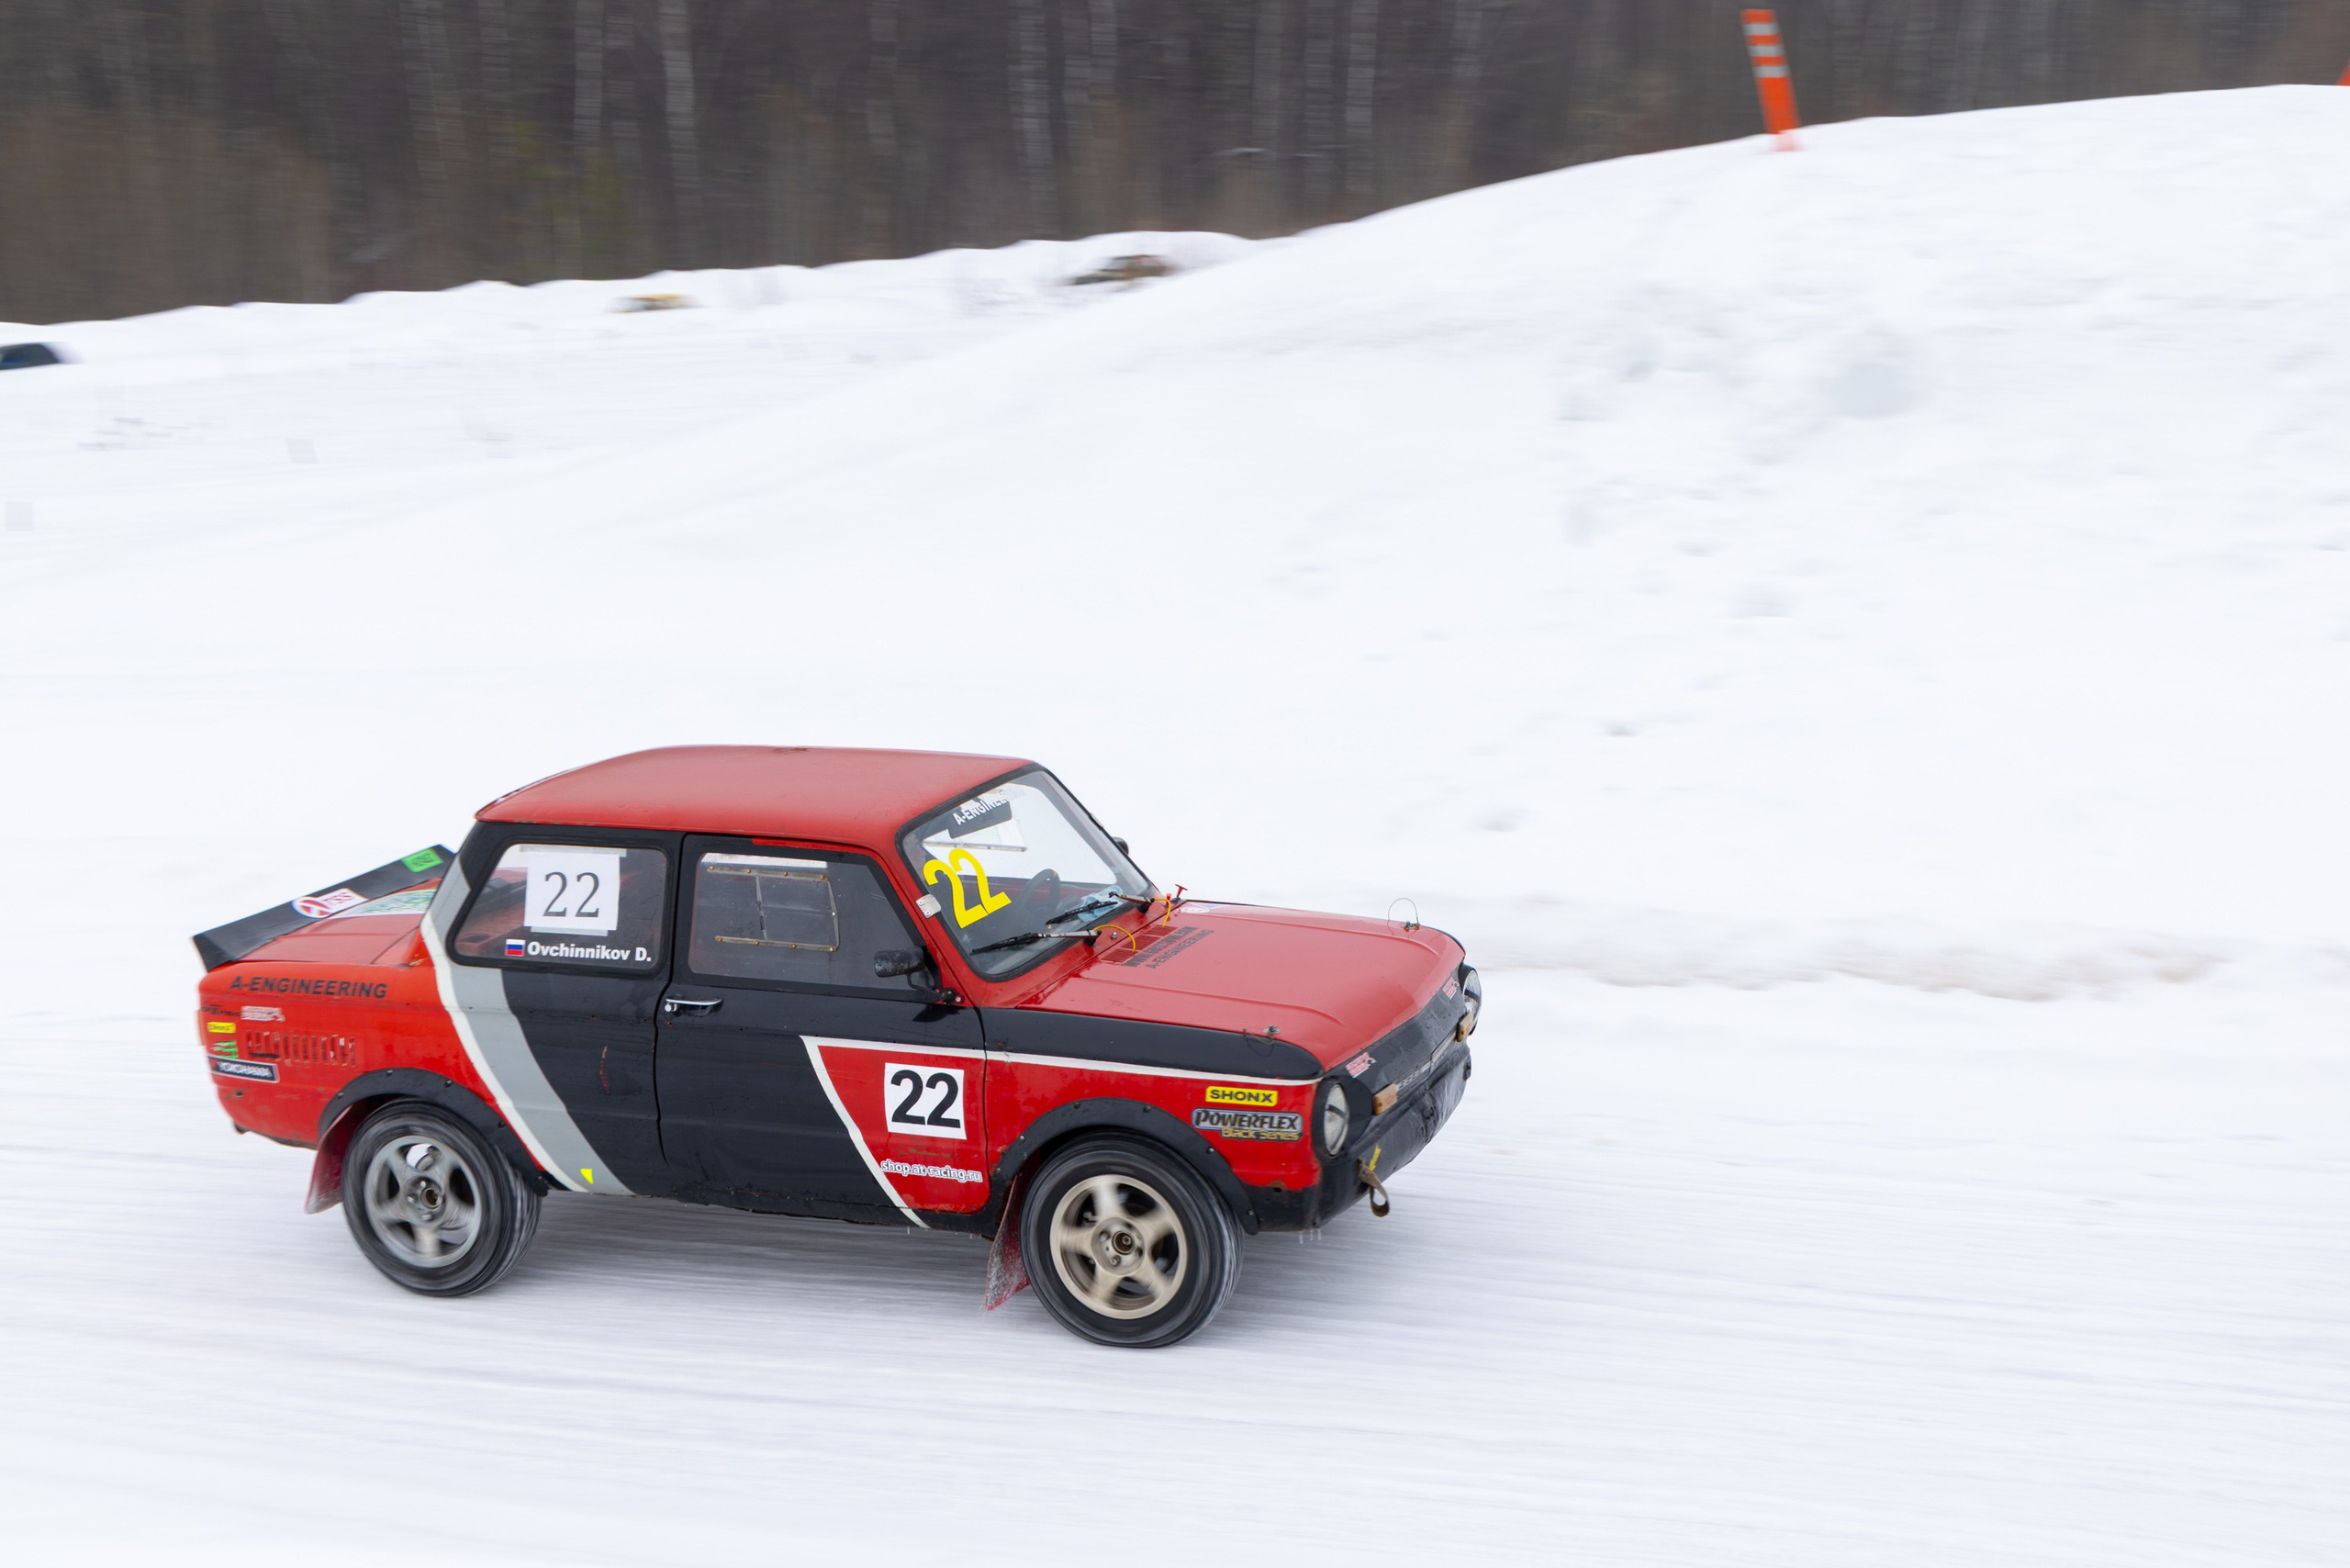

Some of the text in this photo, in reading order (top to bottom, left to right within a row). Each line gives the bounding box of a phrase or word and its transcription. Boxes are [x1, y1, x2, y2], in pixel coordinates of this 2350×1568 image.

[543, 871, 599, 918] 22
[923, 848, 1012, 928] 22
[527, 941, 652, 961] Ovchinnikov D.
[229, 975, 387, 999] A-ENGINEERING
[890, 1070, 961, 1128] 22
[1210, 1089, 1273, 1103] SHONX
[881, 1159, 982, 1182] shop.at-racing.ru
